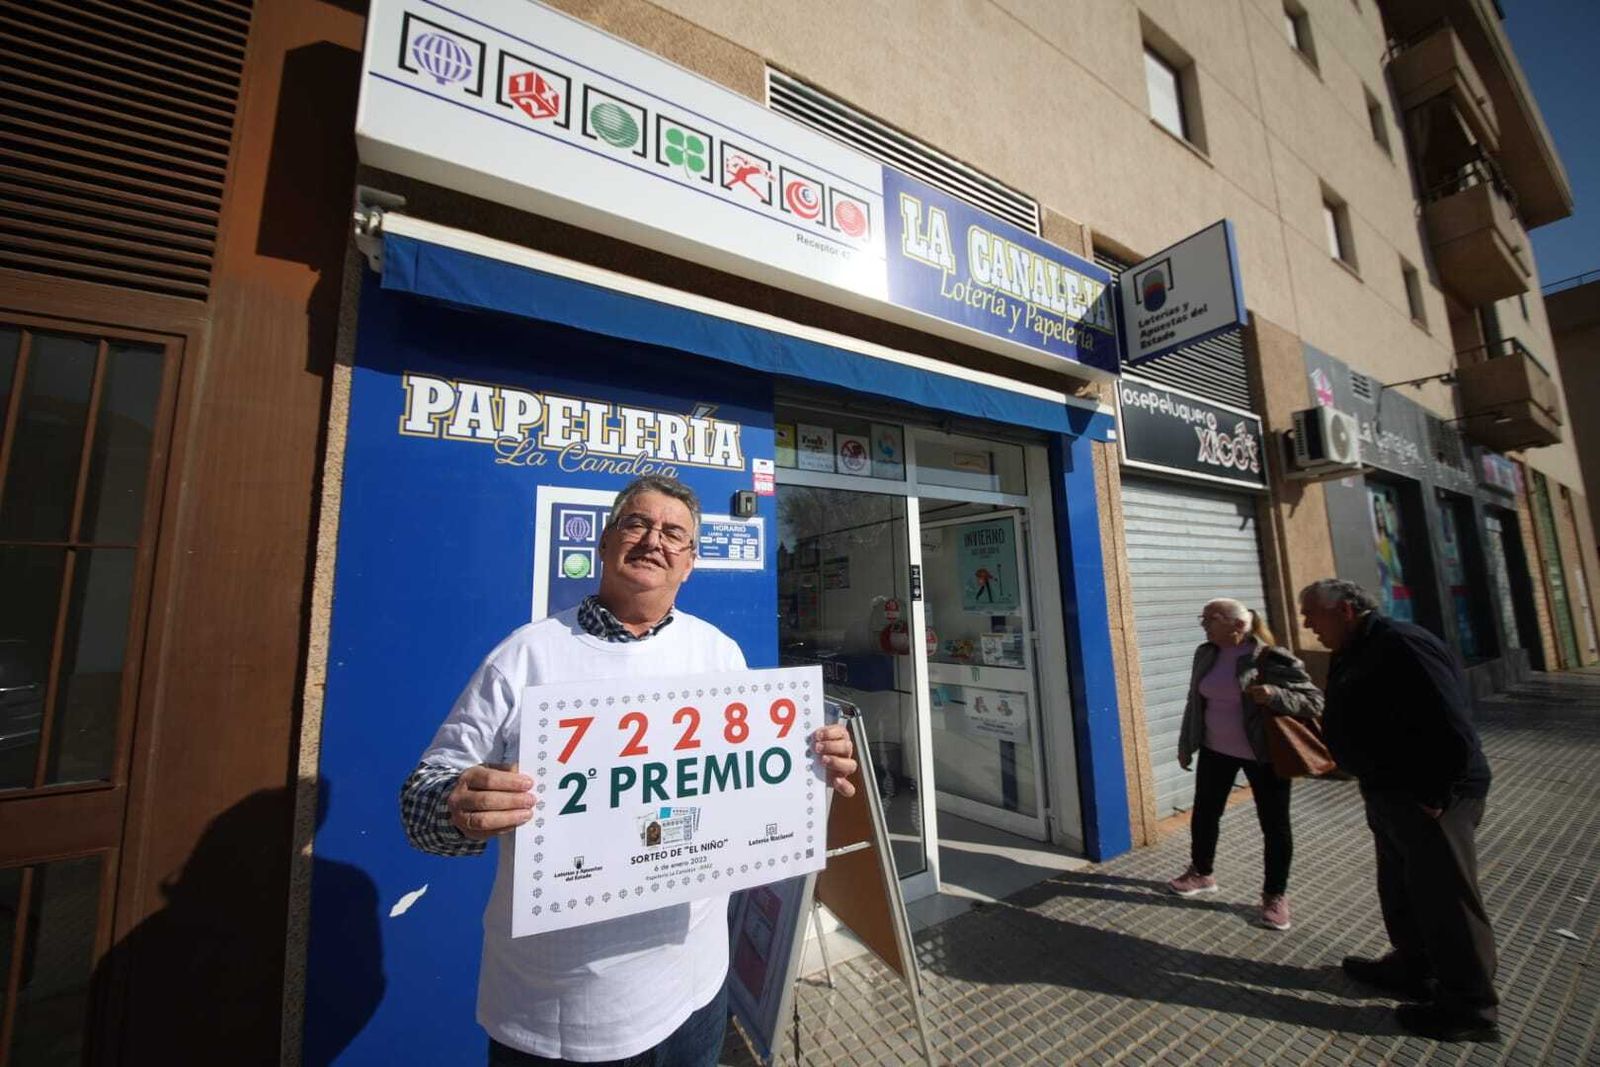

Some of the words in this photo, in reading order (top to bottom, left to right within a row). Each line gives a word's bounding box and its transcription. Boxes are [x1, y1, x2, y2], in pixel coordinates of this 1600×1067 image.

[900, 192, 956, 275] LA
[967, 224, 1115, 336] CANALEJA
[940, 266, 1007, 318] Lotería
[1008, 304, 1022, 333] y
[1025, 301, 1094, 351] Papelería
[1140, 314, 1189, 339] Apuestas
[1190, 303, 1208, 318] del
[1140, 330, 1177, 350] Estado
[399, 370, 746, 472] PAPELERÍA
[494, 435, 548, 467] La
[609, 746, 793, 809] PREMIO
[630, 850, 668, 865] SORTEO
[670, 847, 683, 857] DE
[684, 845, 699, 854] "EL
[700, 838, 729, 851] NIÑO"
[661, 862, 670, 870] de
[671, 860, 689, 869] enero
